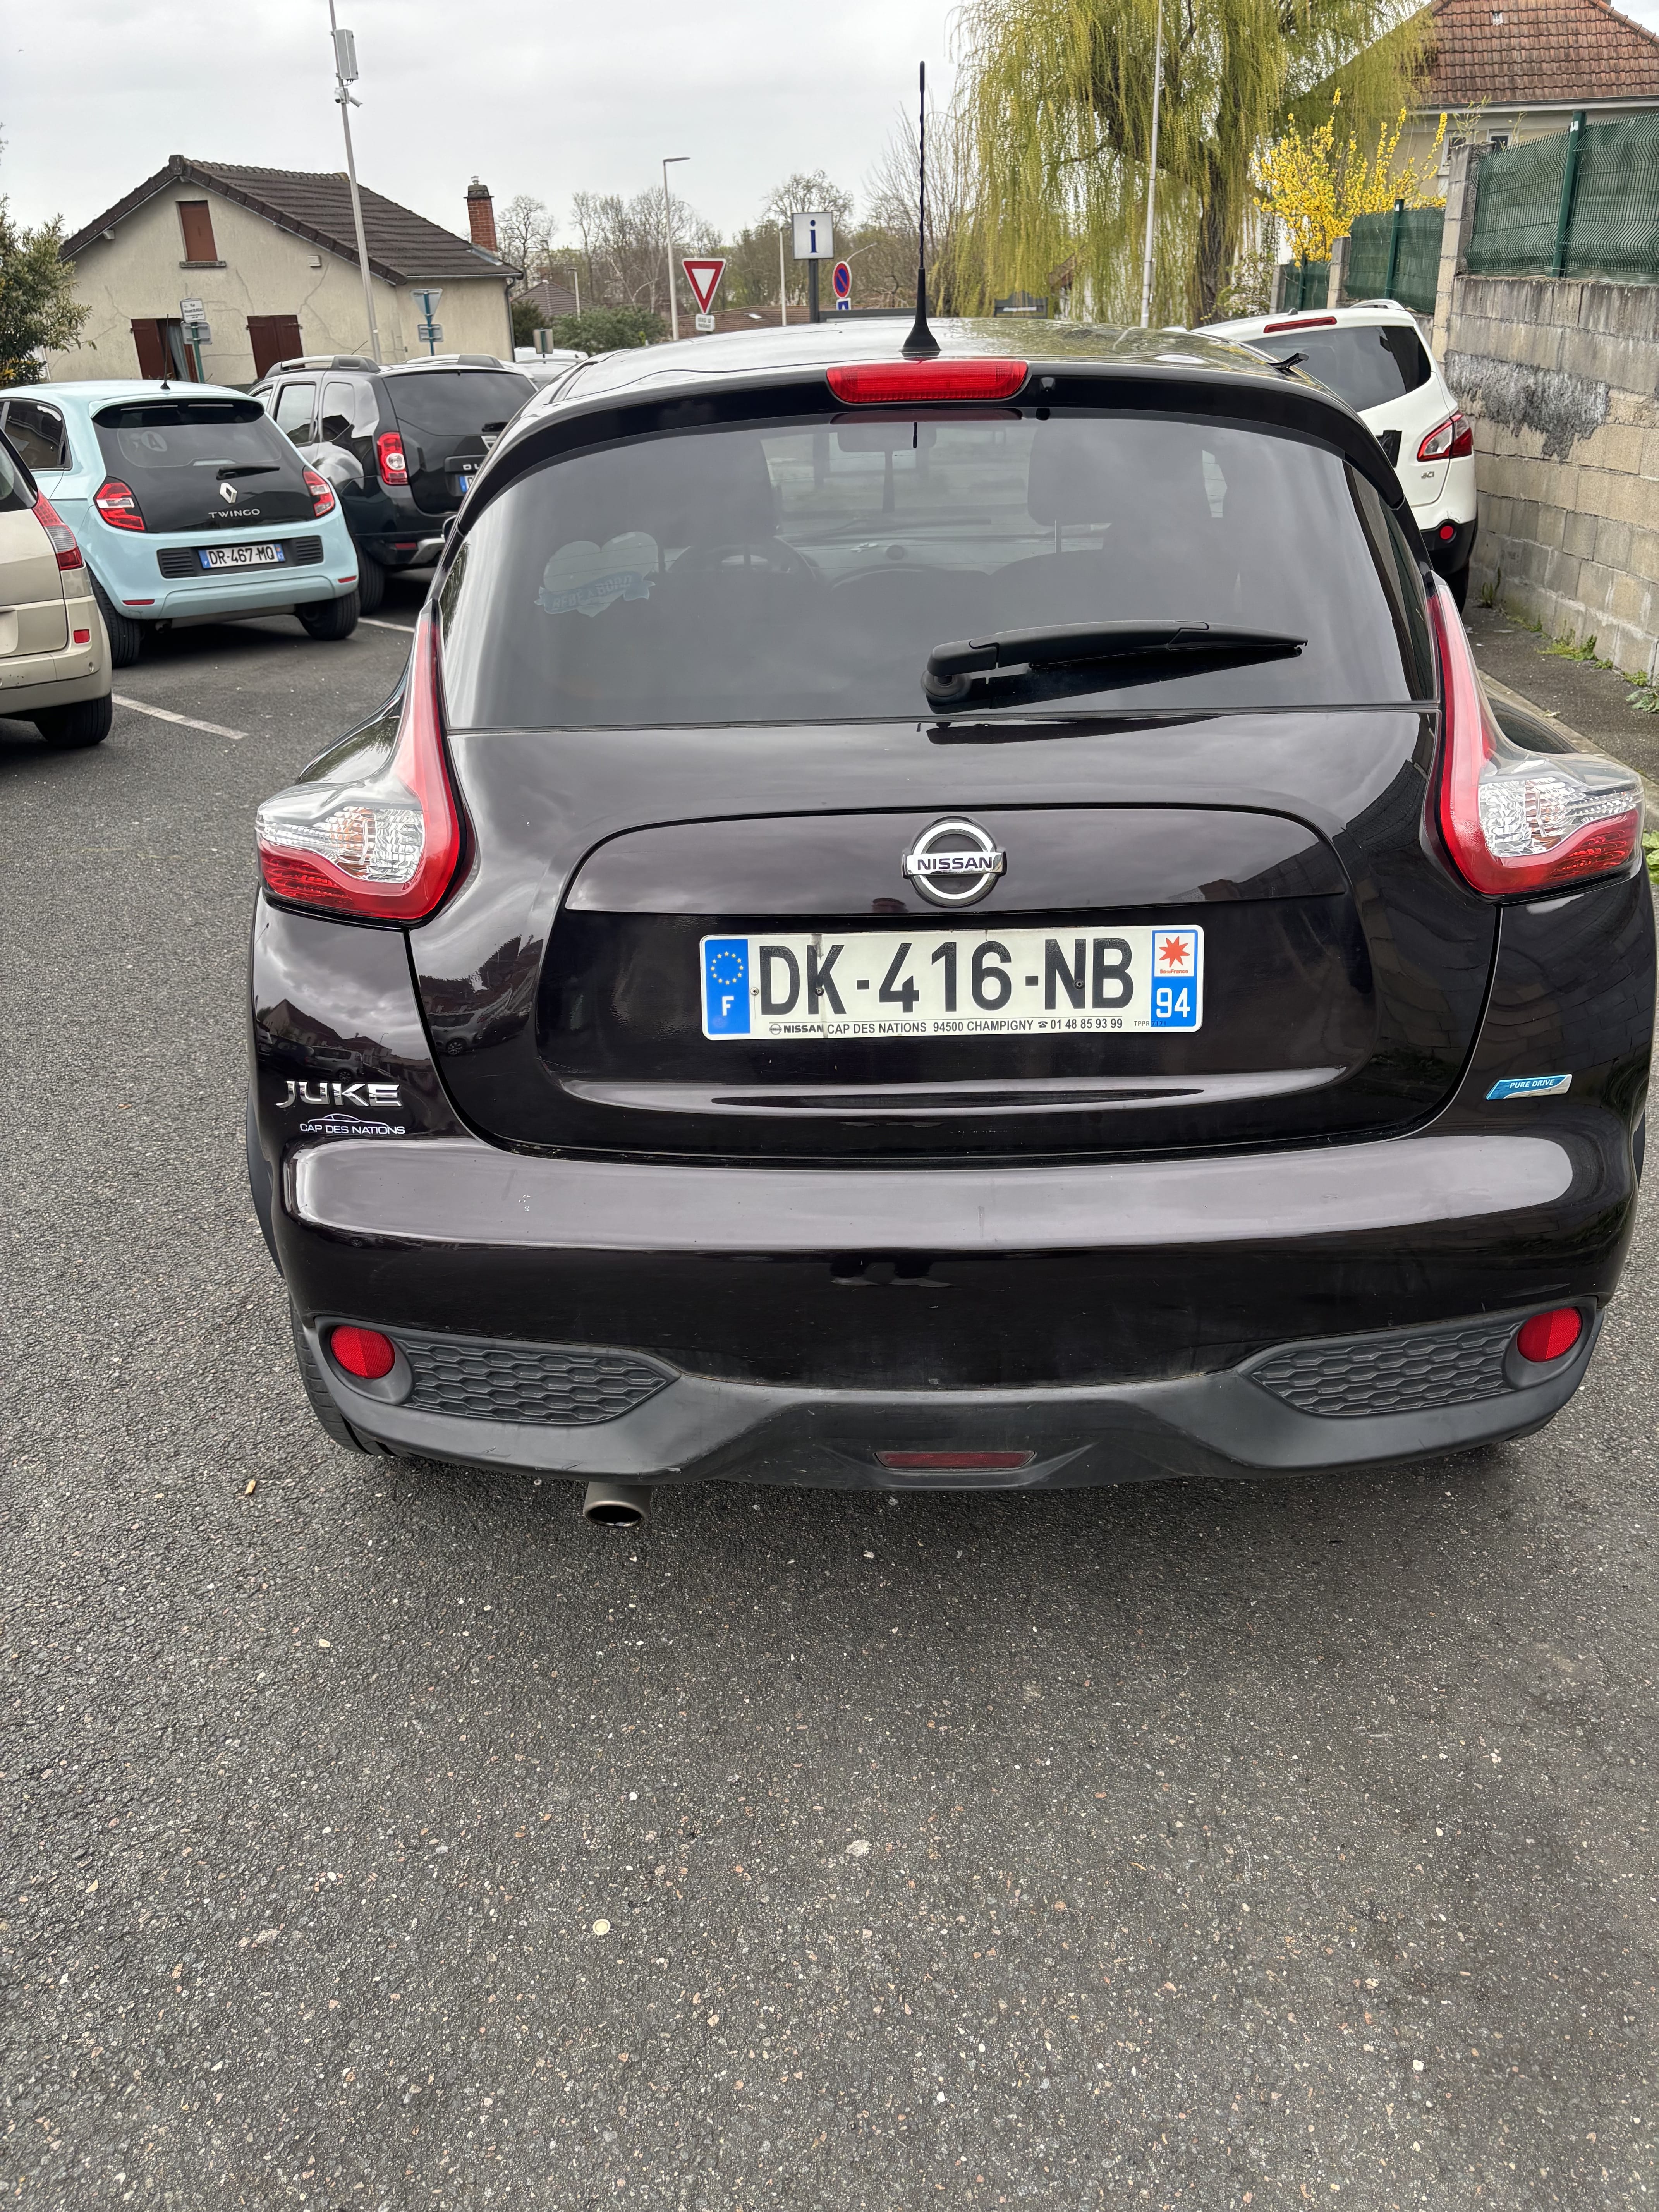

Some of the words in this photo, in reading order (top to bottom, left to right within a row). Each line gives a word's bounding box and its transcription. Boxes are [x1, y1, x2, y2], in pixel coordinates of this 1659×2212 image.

[208, 508, 261, 519] TWINGO
[208, 546, 275, 565] DR-467-MQ
[917, 857, 992, 871] NISSAN
[759, 938, 1133, 1015] DK-416-NB
[722, 996, 735, 1016] F
[1156, 987, 1190, 1018] 94
[783, 1025, 824, 1033] NISSAN
[827, 1024, 850, 1034] CAP
[853, 1023, 875, 1034] DES
[879, 1022, 927, 1033] NATIONS
[933, 1021, 963, 1032] 94500
[967, 1020, 1034, 1031] CHAMPIGNY
[1050, 1019, 1061, 1029] 01
[1065, 1019, 1077, 1029] 48
[1080, 1018, 1092, 1029] 85
[1096, 1018, 1108, 1029] 93
[1110, 1018, 1123, 1029] 99
[1509, 1081, 1530, 1089] PURE
[1531, 1079, 1555, 1087] DRIVE
[275, 1080, 402, 1108] JUKE
[299, 1123, 323, 1132] CAP
[325, 1125, 349, 1133] DES
[352, 1125, 406, 1135] NATIONS
